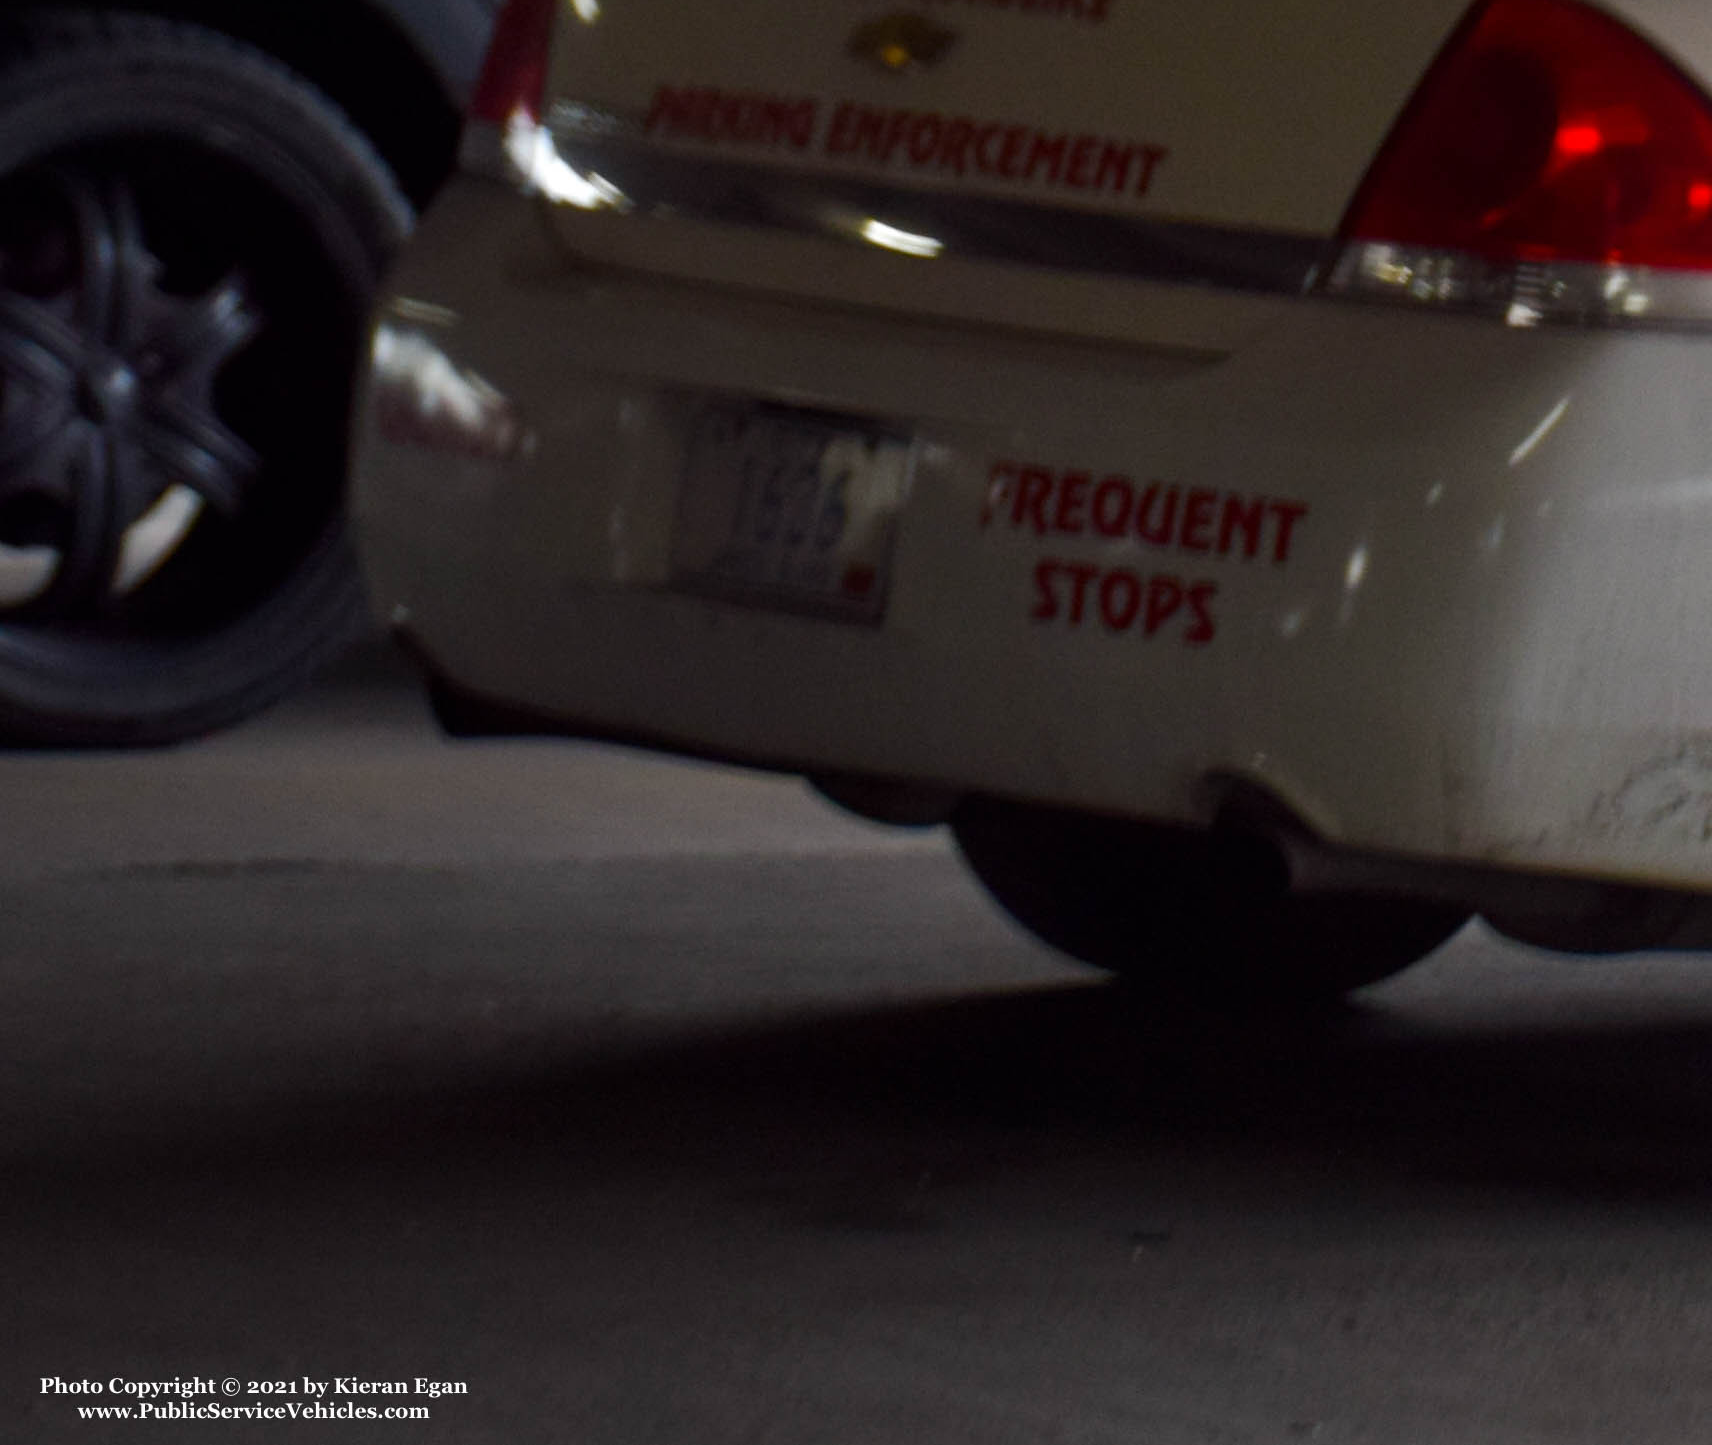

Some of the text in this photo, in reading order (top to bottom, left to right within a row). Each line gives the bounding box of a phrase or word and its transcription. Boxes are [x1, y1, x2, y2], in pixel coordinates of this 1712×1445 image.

[645, 84, 1168, 197] PARKING ENFORCEMENT
[979, 460, 1308, 563] FREQUENT
[1031, 557, 1217, 645] STOPS
